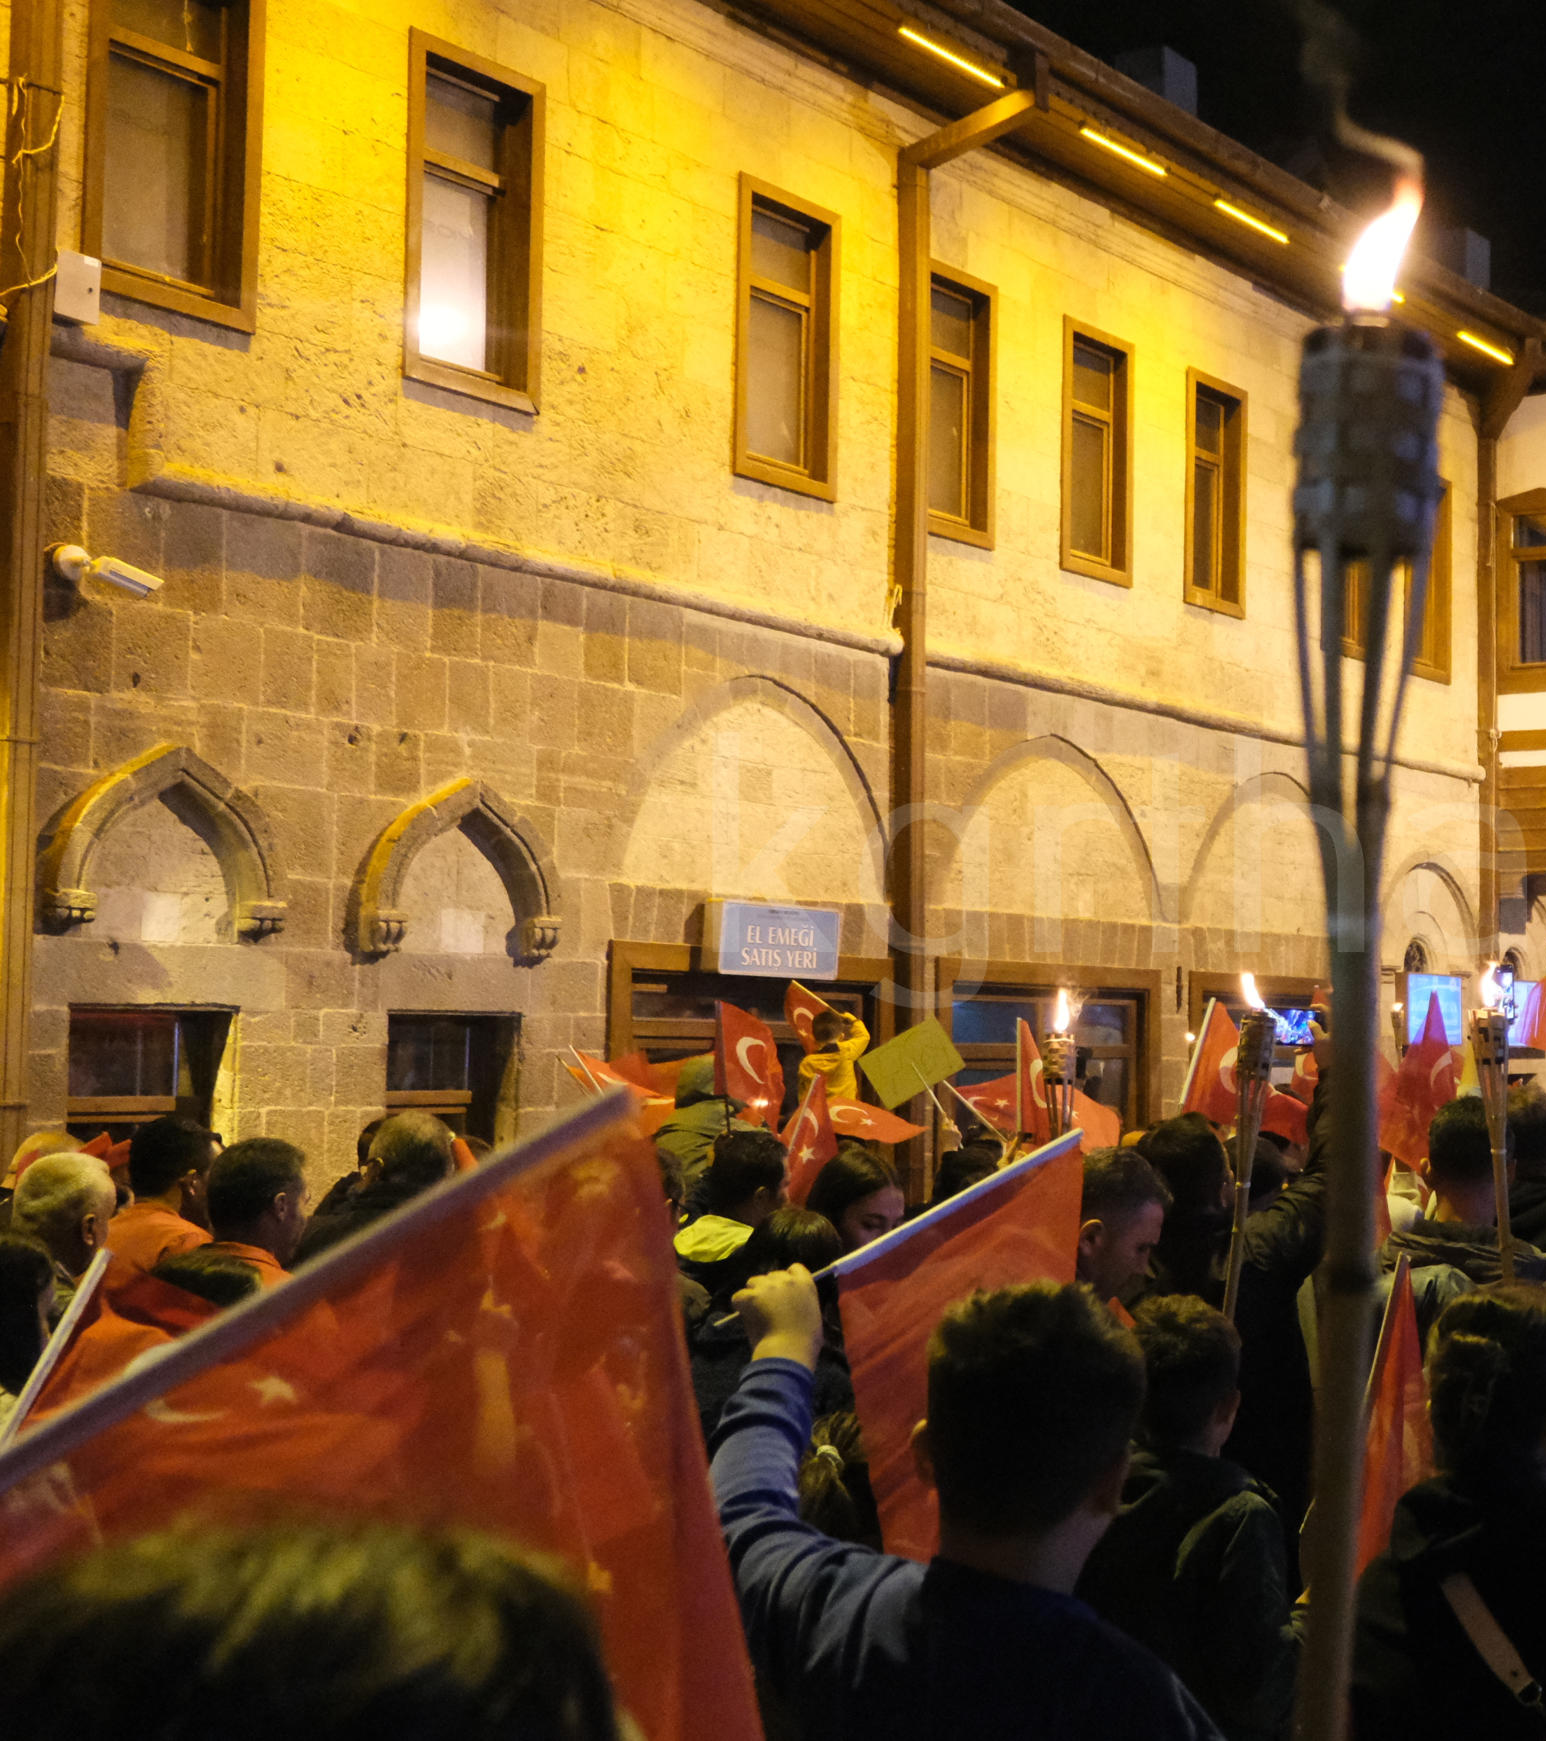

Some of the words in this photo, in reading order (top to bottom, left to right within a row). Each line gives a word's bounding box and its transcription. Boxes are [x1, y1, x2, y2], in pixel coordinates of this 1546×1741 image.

[747, 925, 763, 944] EL
[768, 925, 814, 947] EMEĞİ
[741, 947, 782, 971] SATIŞ
[786, 947, 817, 969] YERİ
